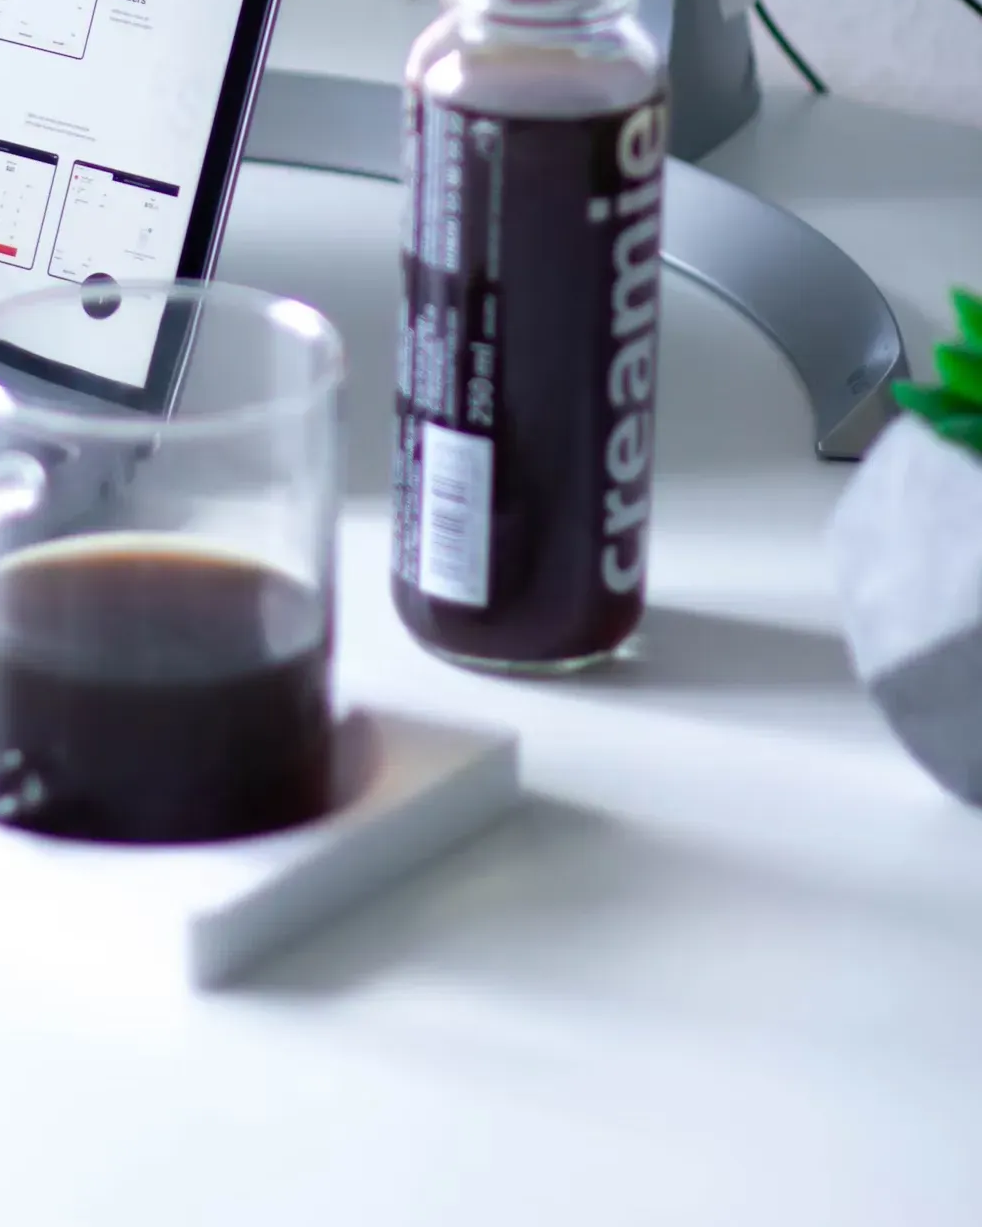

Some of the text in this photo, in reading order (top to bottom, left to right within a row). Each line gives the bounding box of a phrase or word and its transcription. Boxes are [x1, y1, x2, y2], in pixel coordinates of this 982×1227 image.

[466, 341, 495, 427] 250 ml
[587, 102, 668, 595] creamie
